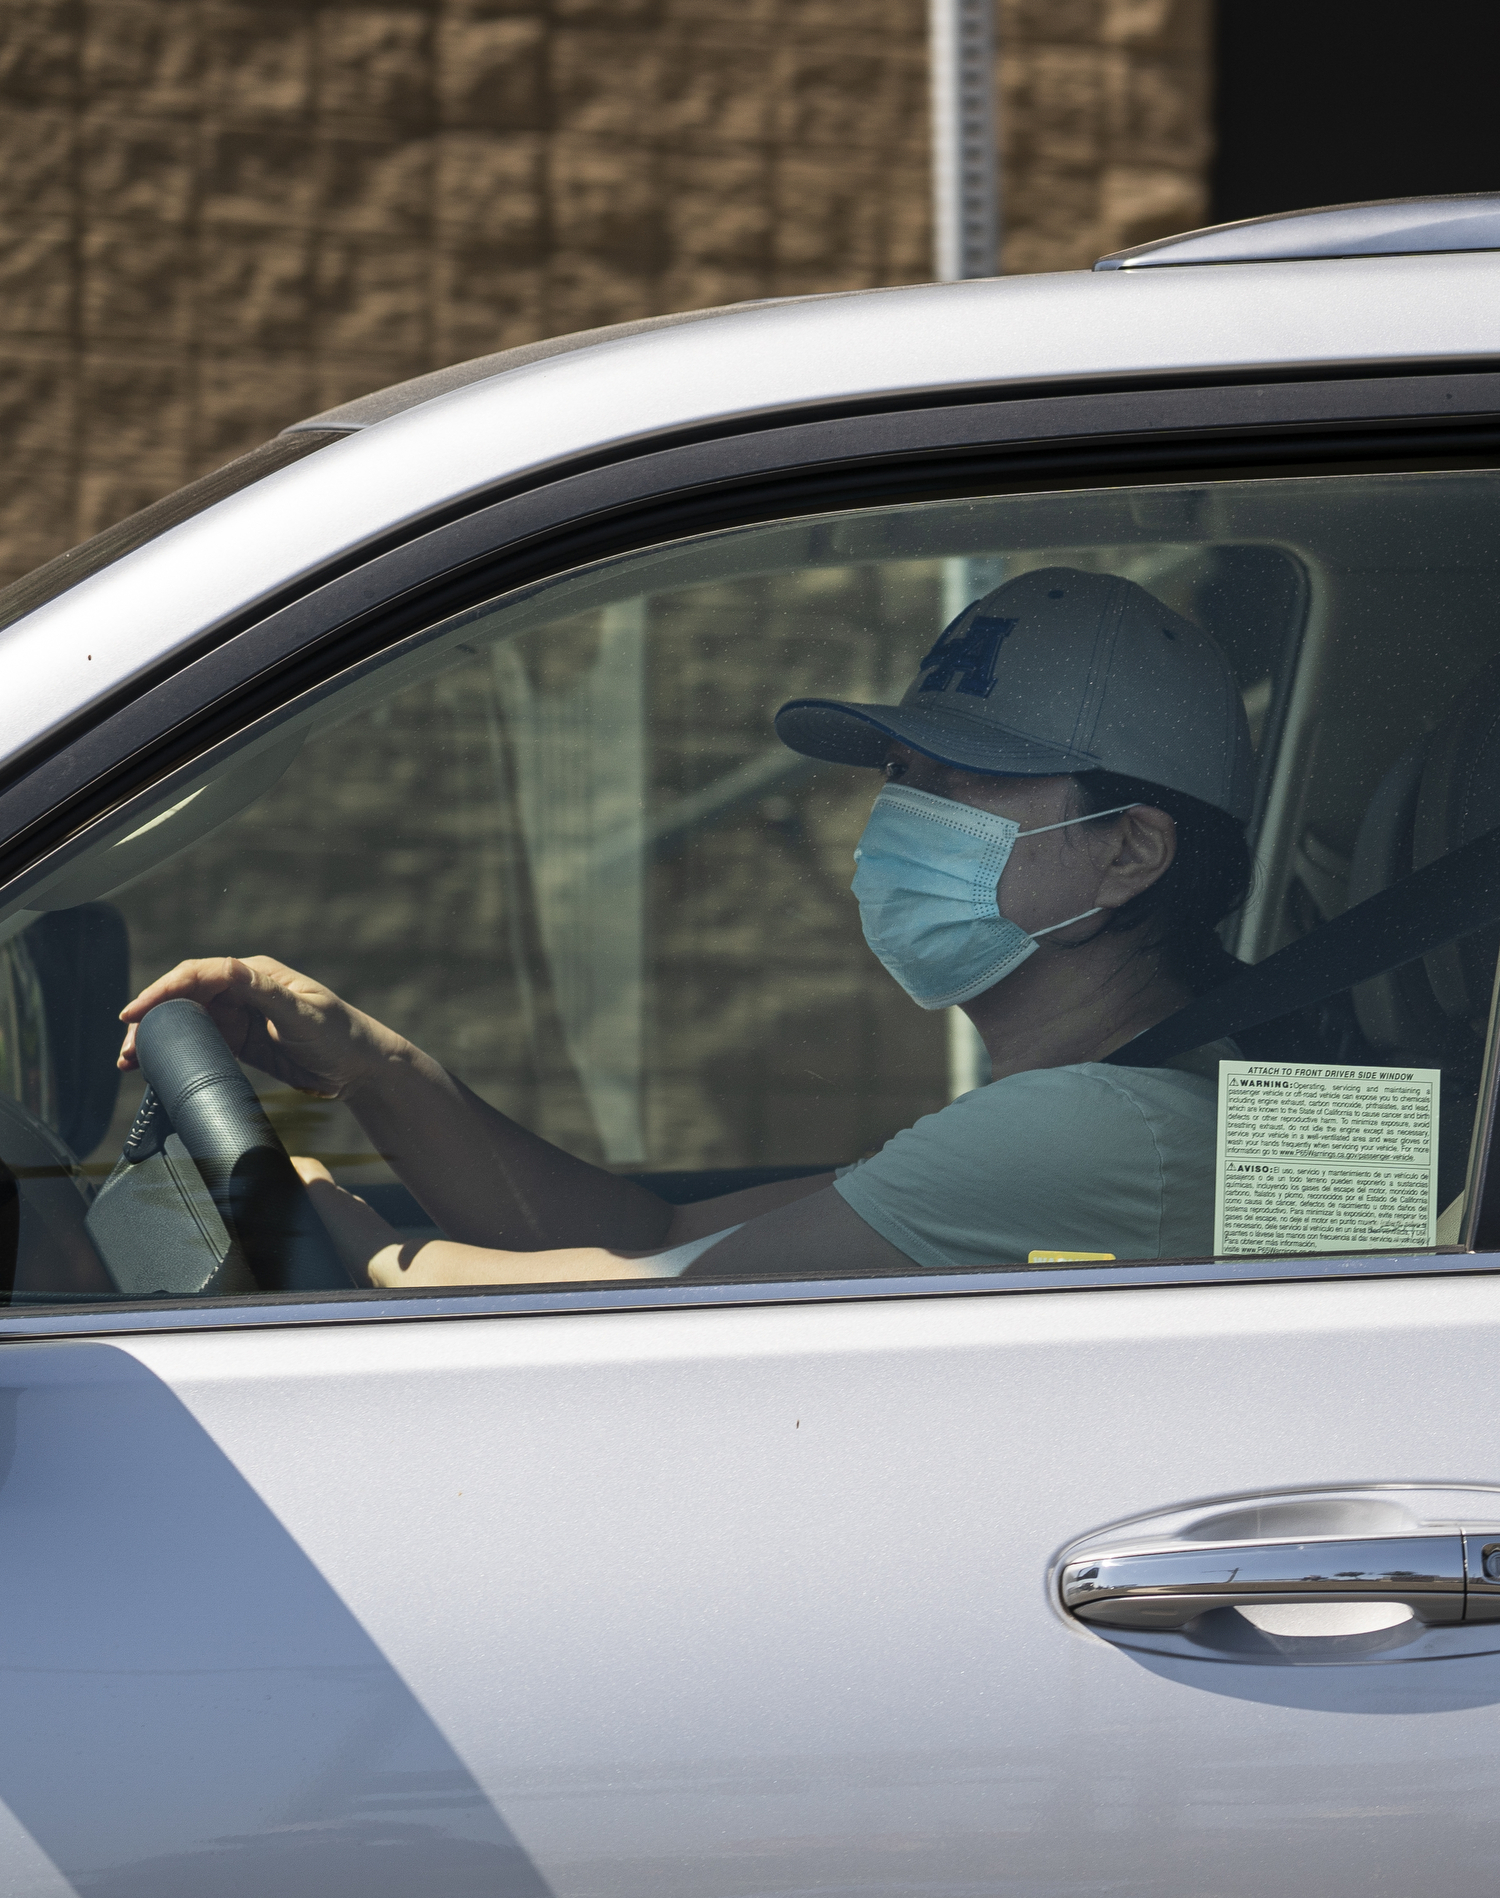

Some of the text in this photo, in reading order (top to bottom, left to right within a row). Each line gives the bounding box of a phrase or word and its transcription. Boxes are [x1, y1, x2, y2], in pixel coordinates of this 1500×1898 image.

[1248, 1066, 1280, 1074] ATTACH
[1294, 1068, 1323, 1076] FRONT
[1324, 1069, 1356, 1077] DRIVER
[1379, 1072, 1414, 1080] WINDOW
[1240, 1080, 1292, 1088] WARNING:
[1237, 1165, 1272, 1173] AVISO:
